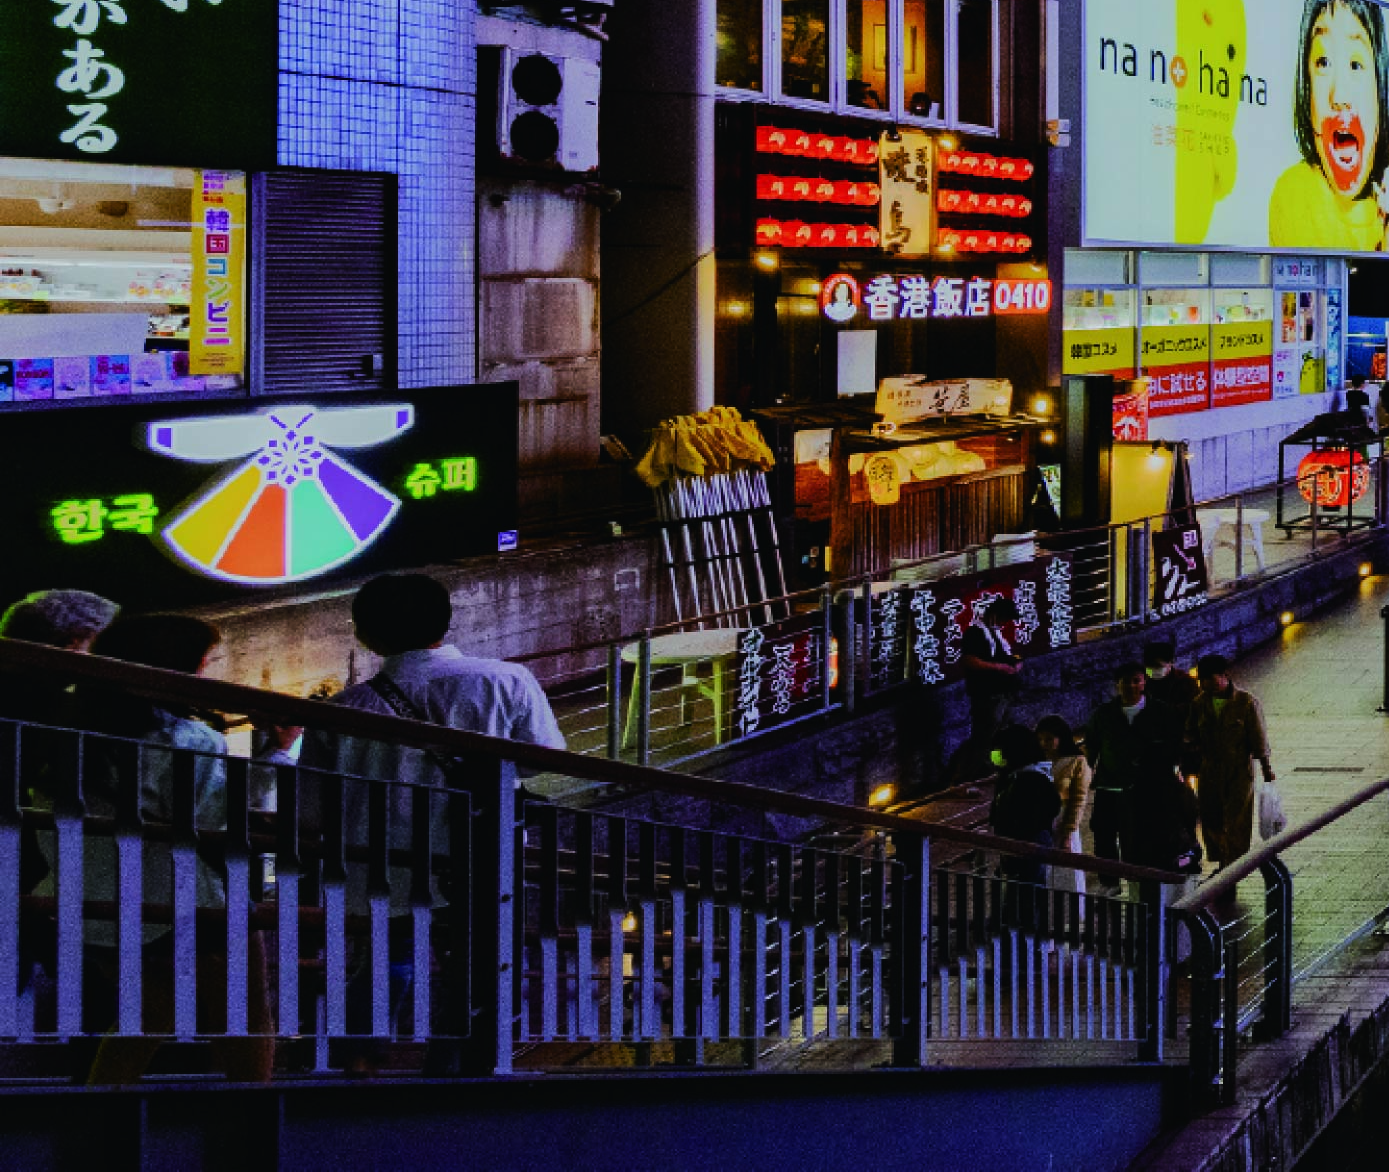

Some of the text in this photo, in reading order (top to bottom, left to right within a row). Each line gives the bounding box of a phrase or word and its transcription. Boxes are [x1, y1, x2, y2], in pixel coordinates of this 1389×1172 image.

[203, 208, 233, 347] 韓国コンビニ
[863, 275, 1049, 319] 香港飯店 0410
[403, 456, 478, 502] 슈퍼
[49, 492, 158, 545] 한국
